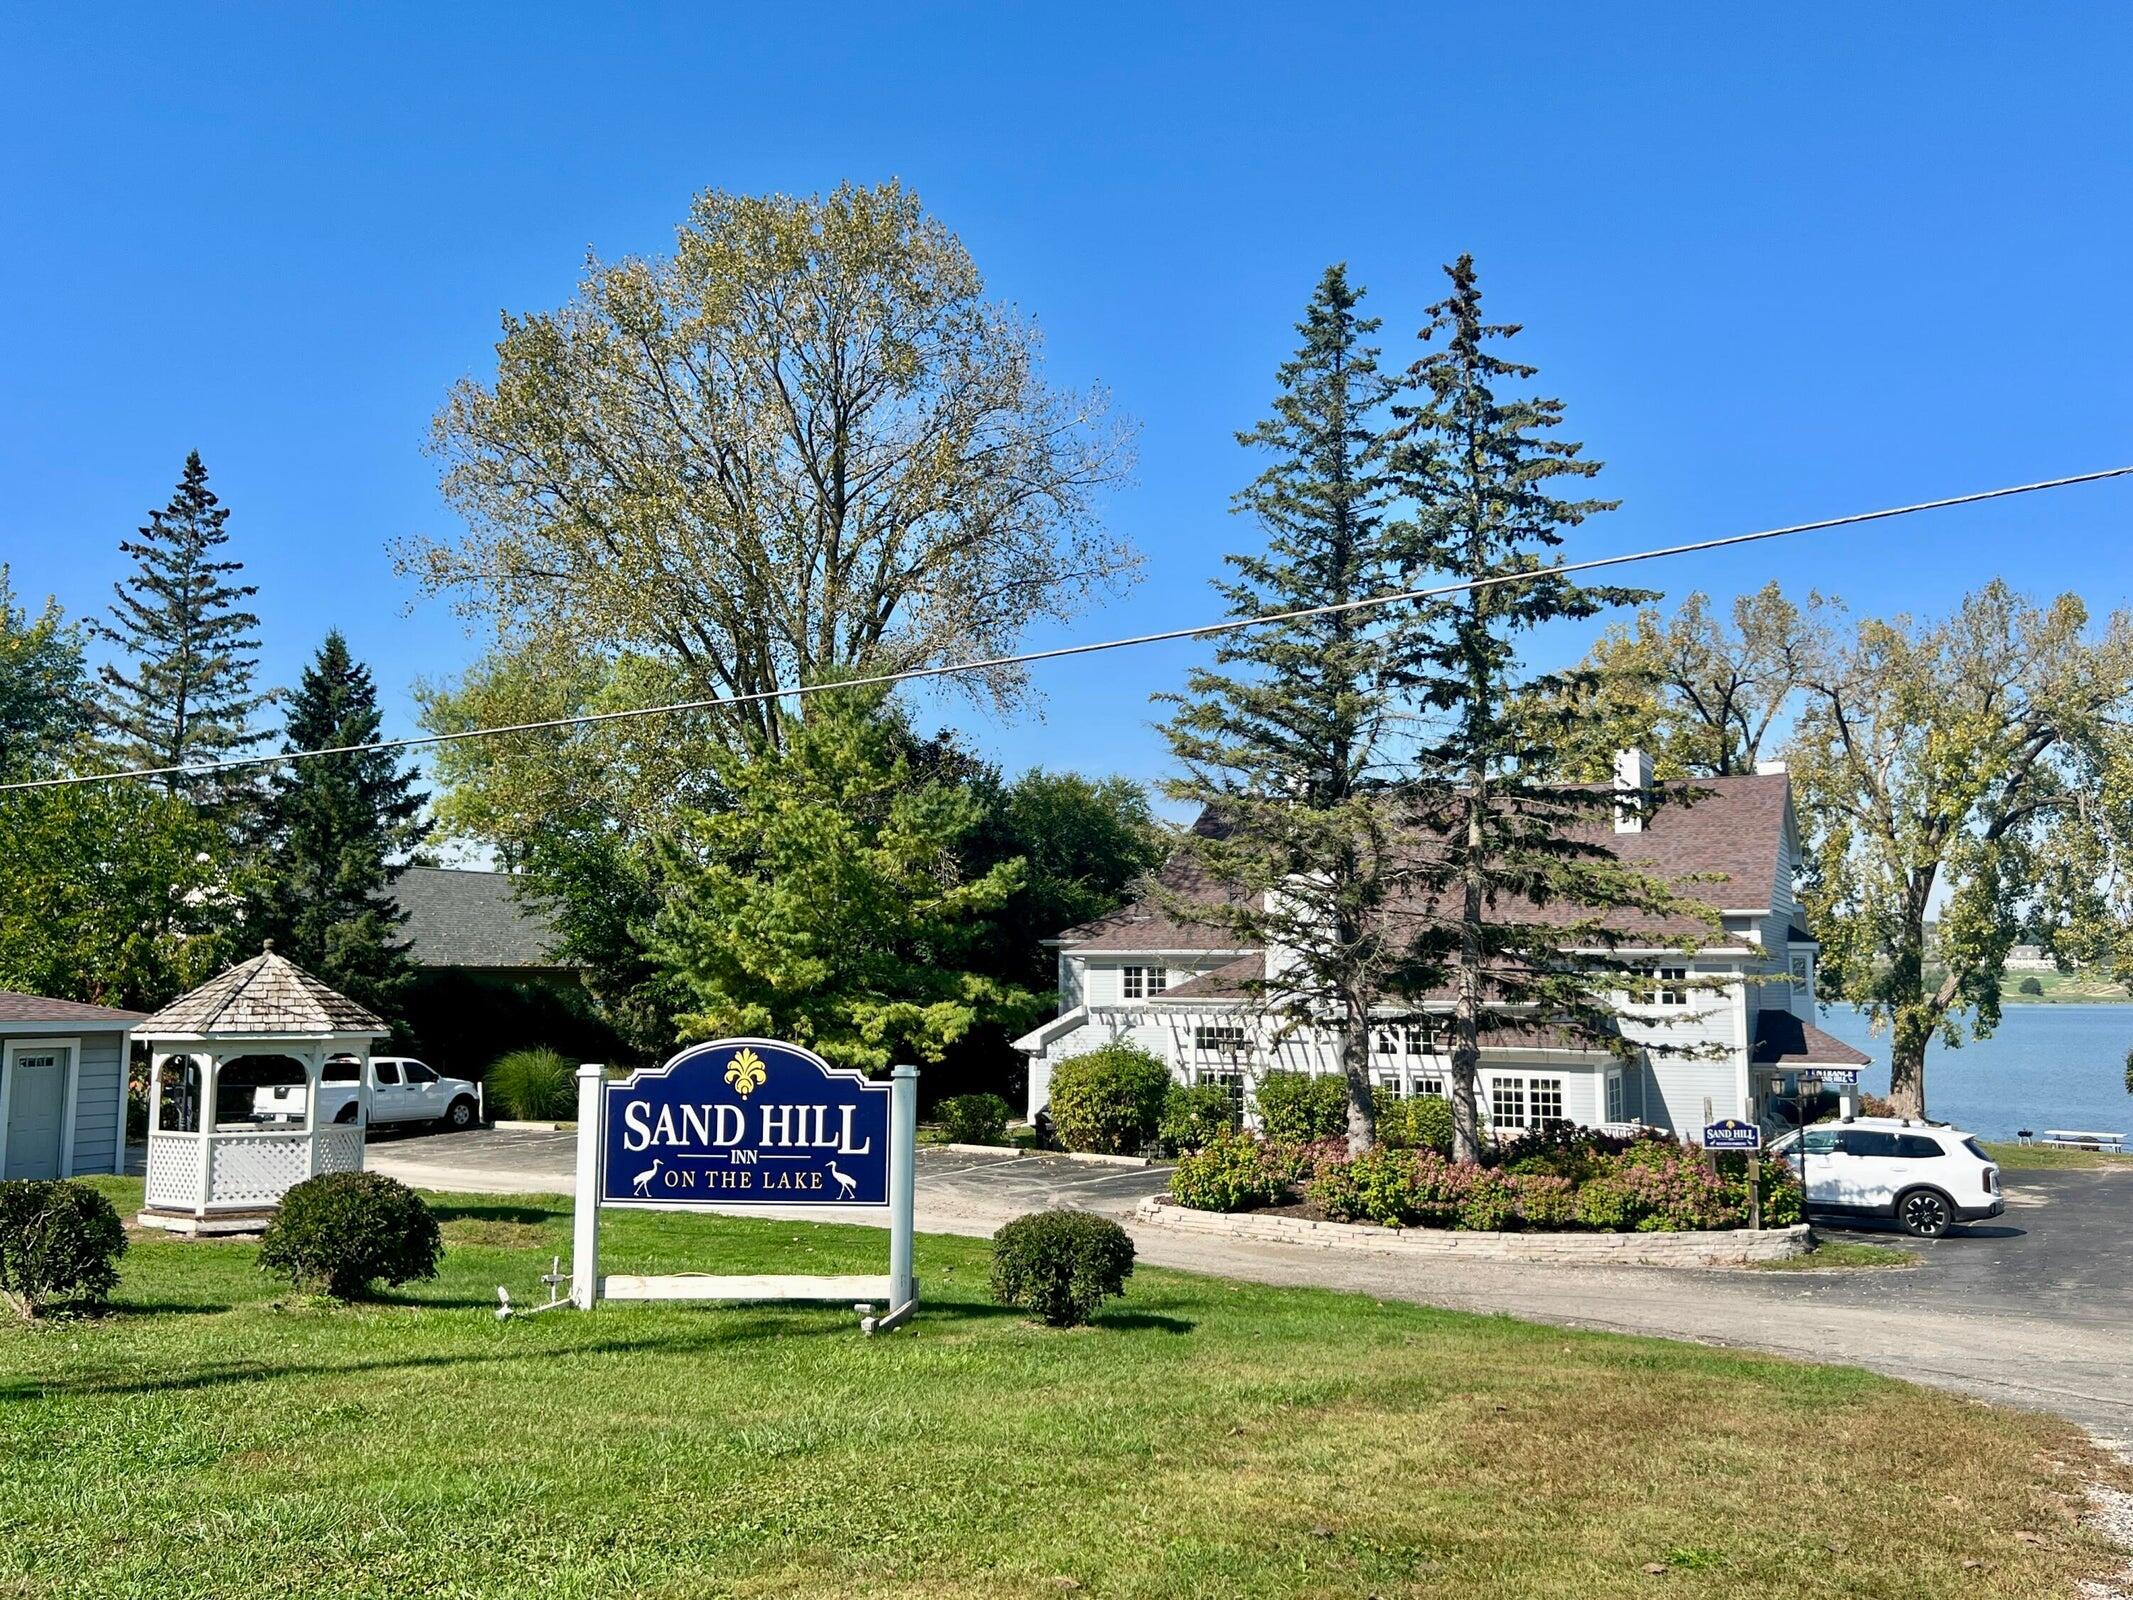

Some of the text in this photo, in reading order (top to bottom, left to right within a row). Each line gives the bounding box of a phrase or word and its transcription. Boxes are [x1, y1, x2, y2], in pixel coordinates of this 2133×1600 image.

[623, 1100, 871, 1155] SAND HILL
[1706, 1128, 1756, 1140] SAND HILL
[730, 1149, 758, 1165] INN
[664, 1170, 824, 1190] ON THE LAKE
